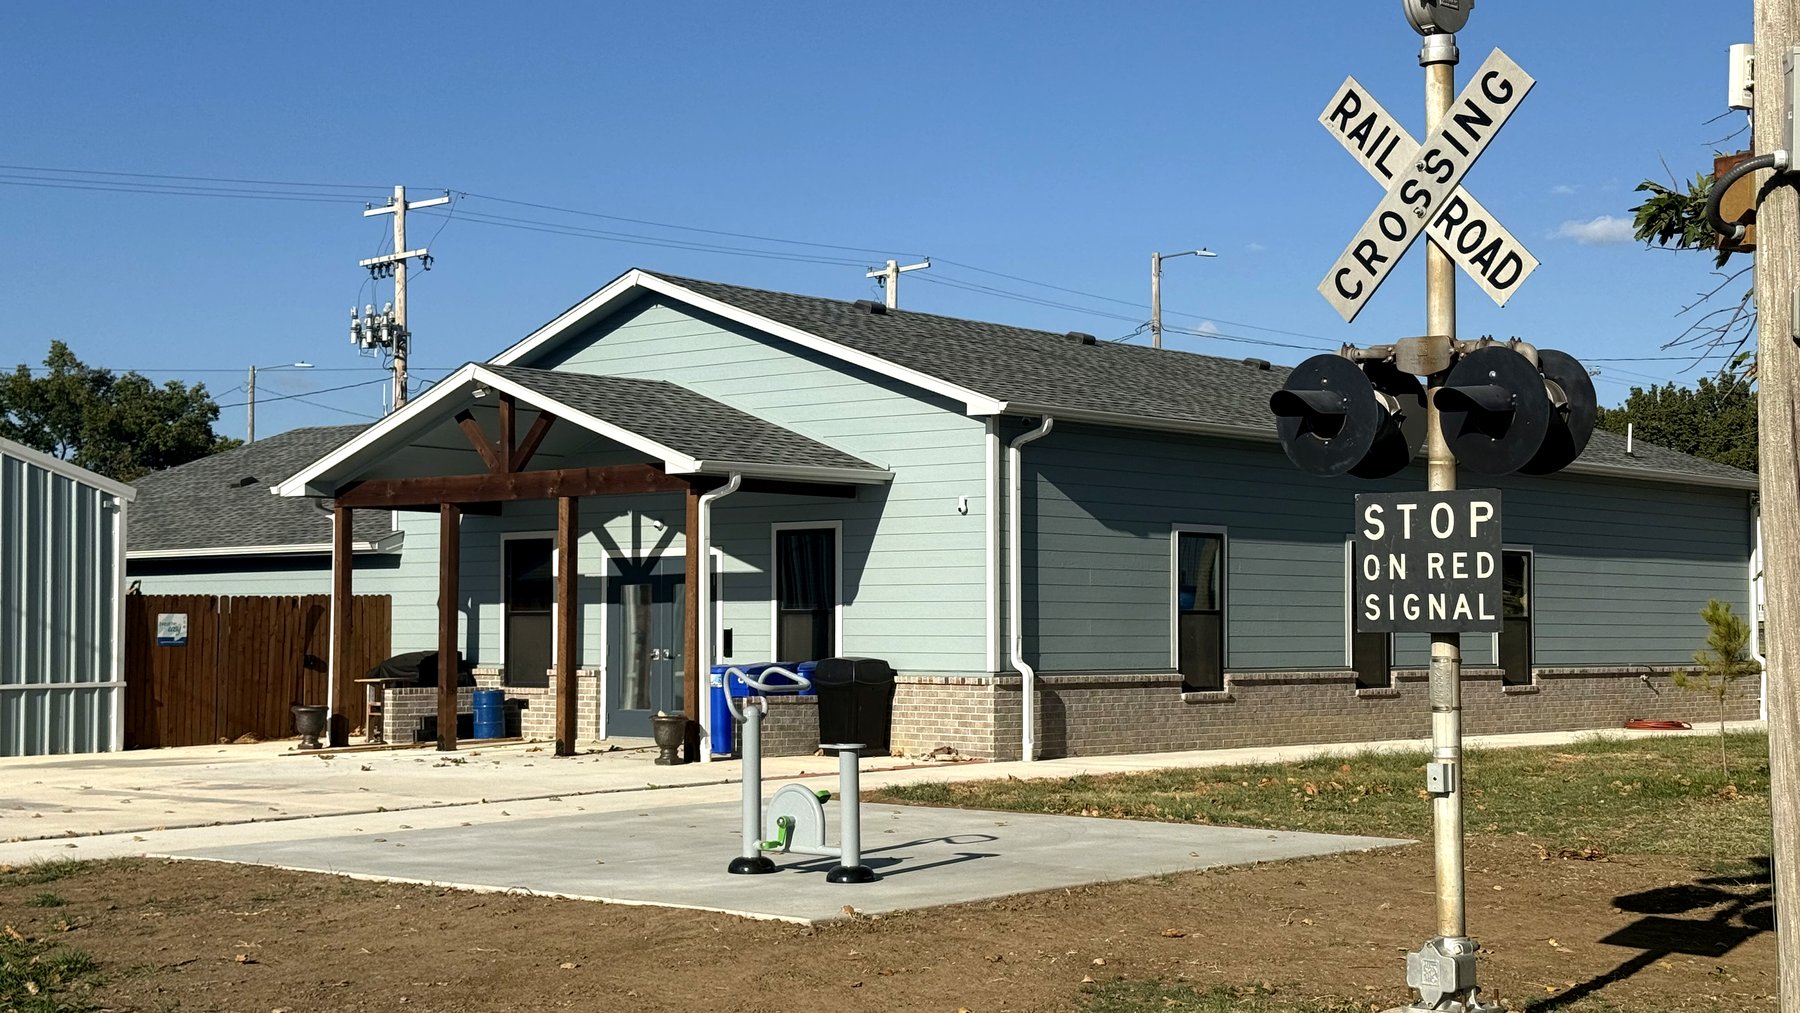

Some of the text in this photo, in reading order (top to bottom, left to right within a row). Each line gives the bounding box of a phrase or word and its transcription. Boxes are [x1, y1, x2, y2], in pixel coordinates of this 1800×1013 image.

[1330, 88, 1523, 290] RAIL ROAD
[1334, 70, 1514, 300] CROSSING
[1363, 501, 1494, 541] STOP
[1363, 551, 1495, 581] ON RED
[1364, 593, 1496, 621] SIGNAL
